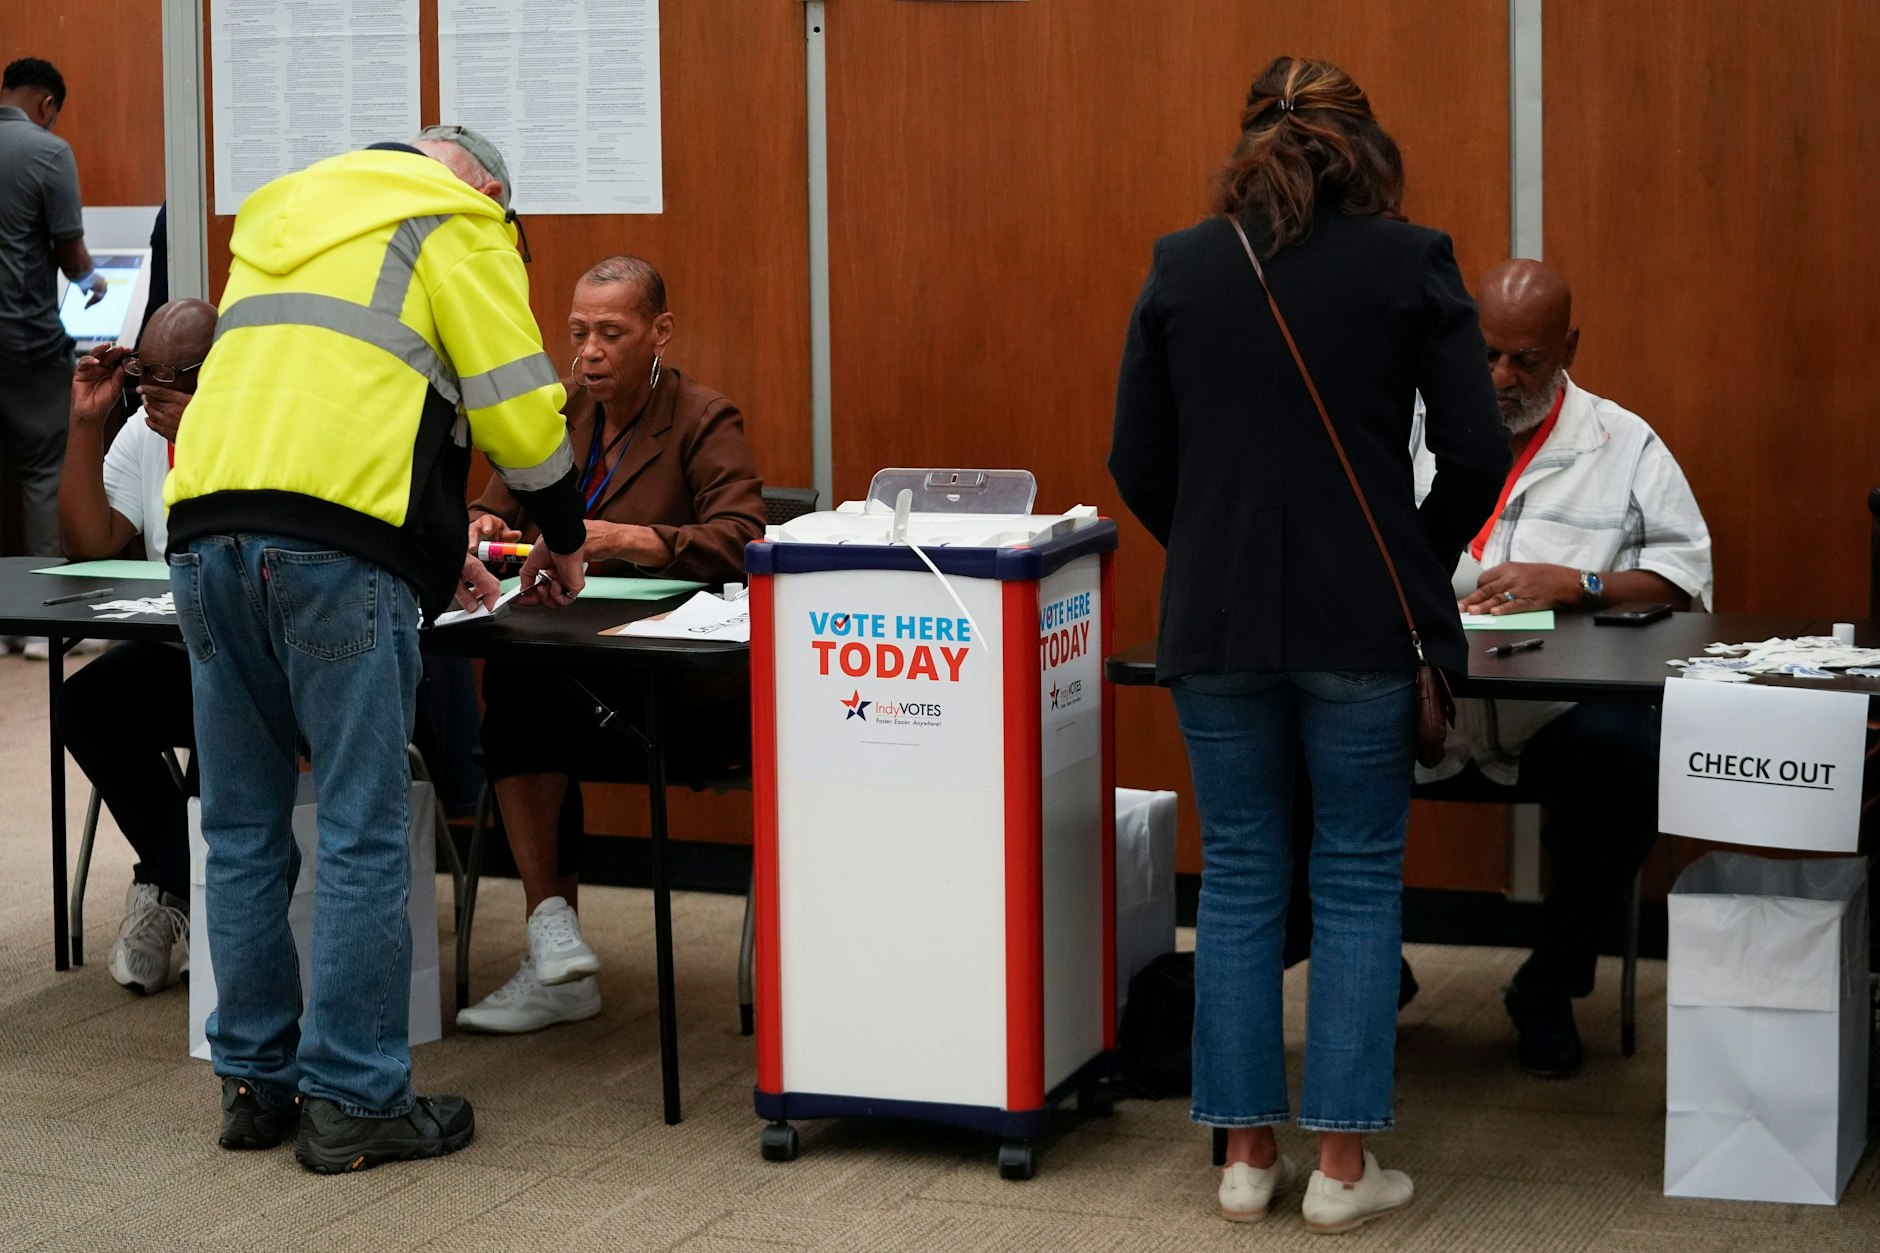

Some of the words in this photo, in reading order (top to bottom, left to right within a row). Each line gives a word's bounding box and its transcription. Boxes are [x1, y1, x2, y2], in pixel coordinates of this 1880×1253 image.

[808, 611, 886, 638] VOTE
[896, 615, 971, 642] HERE
[1040, 600, 1064, 631] VOTE
[1066, 591, 1090, 622] HERE
[811, 640, 970, 682] TODAY
[1040, 620, 1090, 671] TODAY
[875, 701, 942, 718] IndyVOTES
[1688, 751, 1771, 779] CHECK
[1779, 760, 1836, 785] OUT
